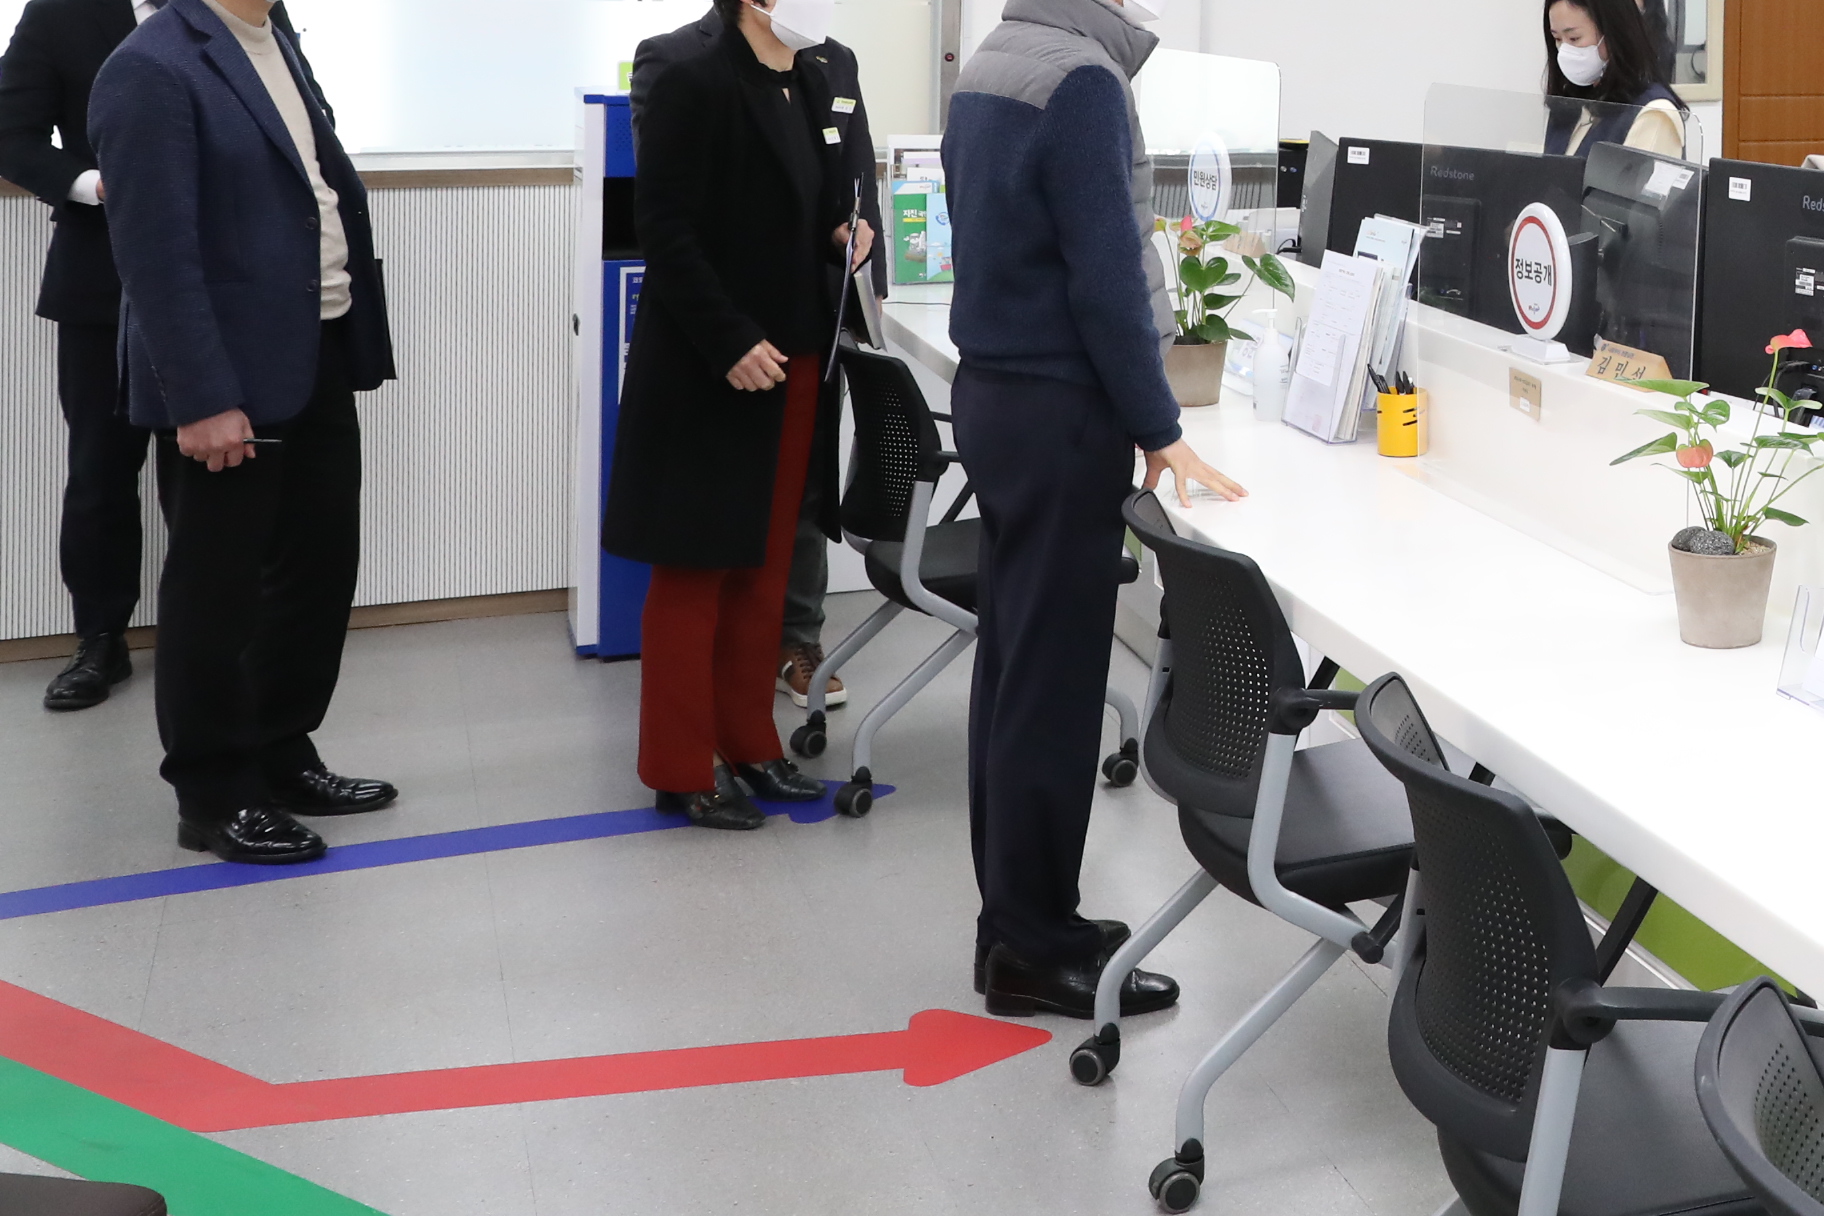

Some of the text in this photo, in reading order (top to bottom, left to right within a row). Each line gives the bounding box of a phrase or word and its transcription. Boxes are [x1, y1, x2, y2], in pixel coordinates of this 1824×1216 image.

[1194, 171, 1217, 191] 민원상담
[1430, 165, 1475, 181] Redstone
[1516, 258, 1552, 286] 정보공개
